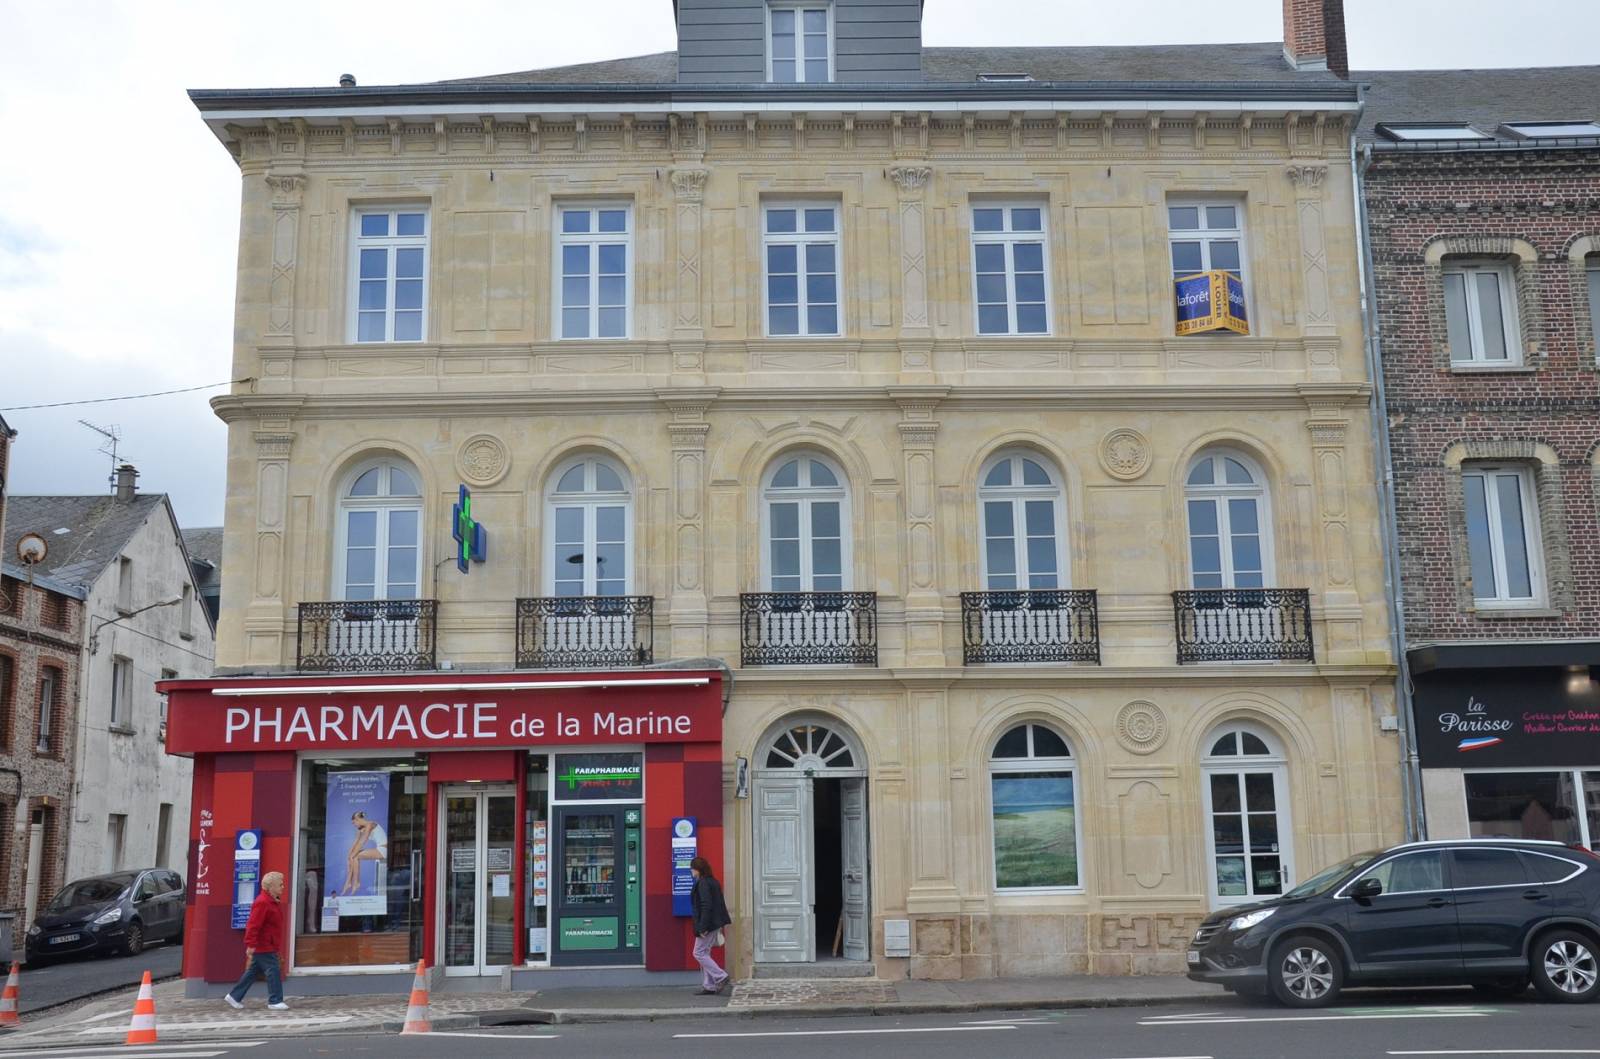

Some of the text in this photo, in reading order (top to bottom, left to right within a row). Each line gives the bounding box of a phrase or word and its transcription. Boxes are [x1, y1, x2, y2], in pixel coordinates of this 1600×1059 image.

[1177, 291, 1209, 306] laforêt
[1214, 286, 1222, 319] LOUER
[1467, 696, 1485, 713] la
[225, 702, 691, 744] PHARMACIE de la Marine
[1438, 713, 1513, 733] Parisse
[574, 766, 641, 774] PARAPHARMACIE
[565, 929, 613, 937] PARAPHARMACIE
